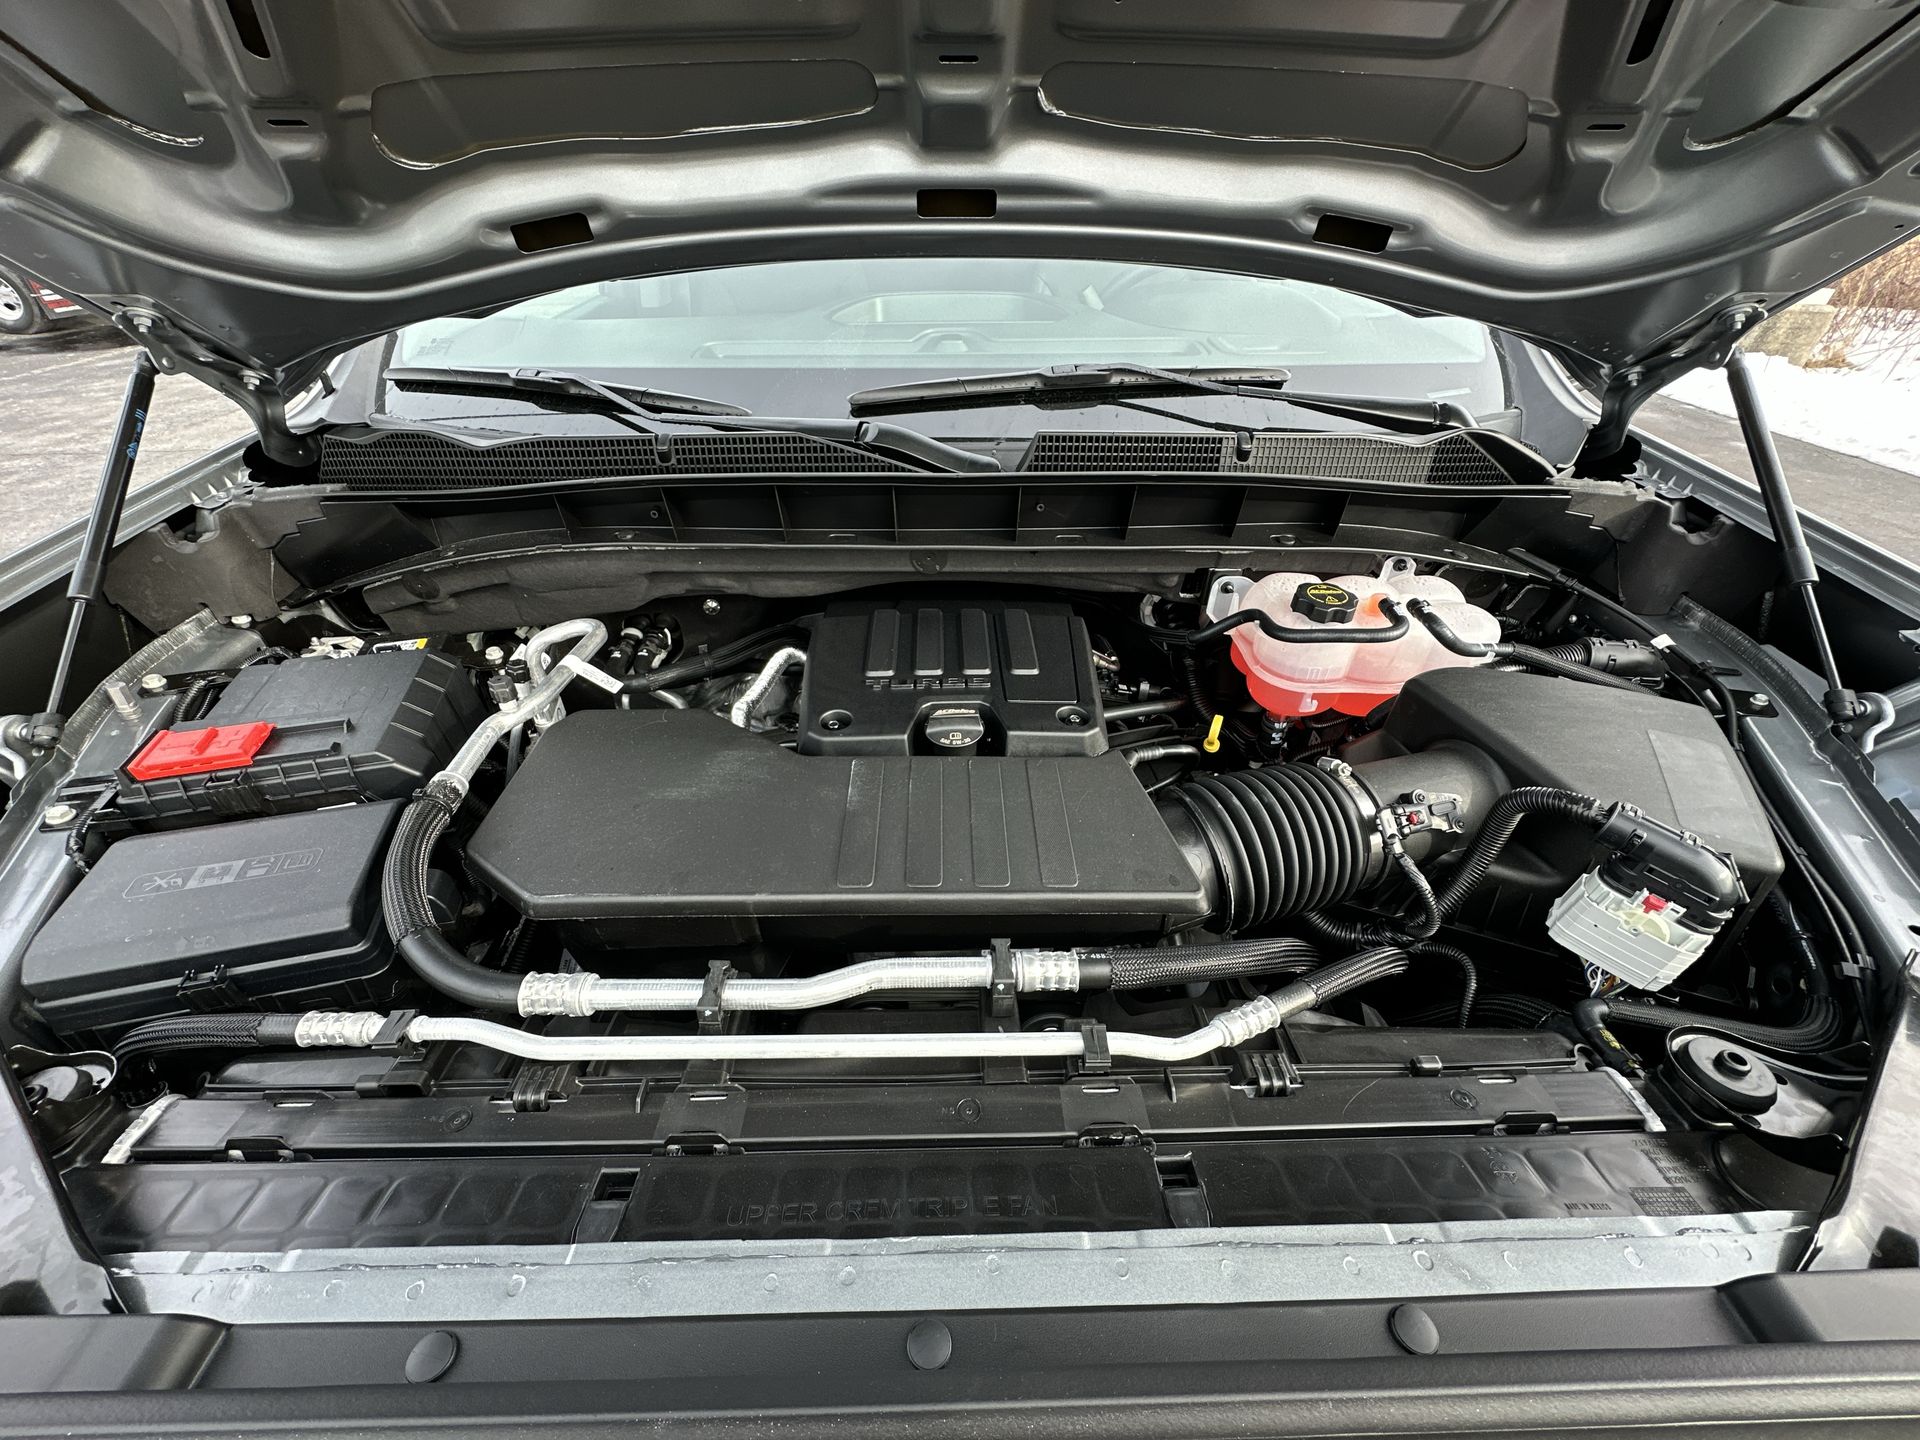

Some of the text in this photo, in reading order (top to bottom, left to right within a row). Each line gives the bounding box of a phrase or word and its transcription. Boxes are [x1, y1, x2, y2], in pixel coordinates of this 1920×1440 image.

[726, 1201, 818, 1227] UPPER
[908, 1195, 1001, 1217] TRIPLE
[1008, 1193, 1058, 1216] FAN
